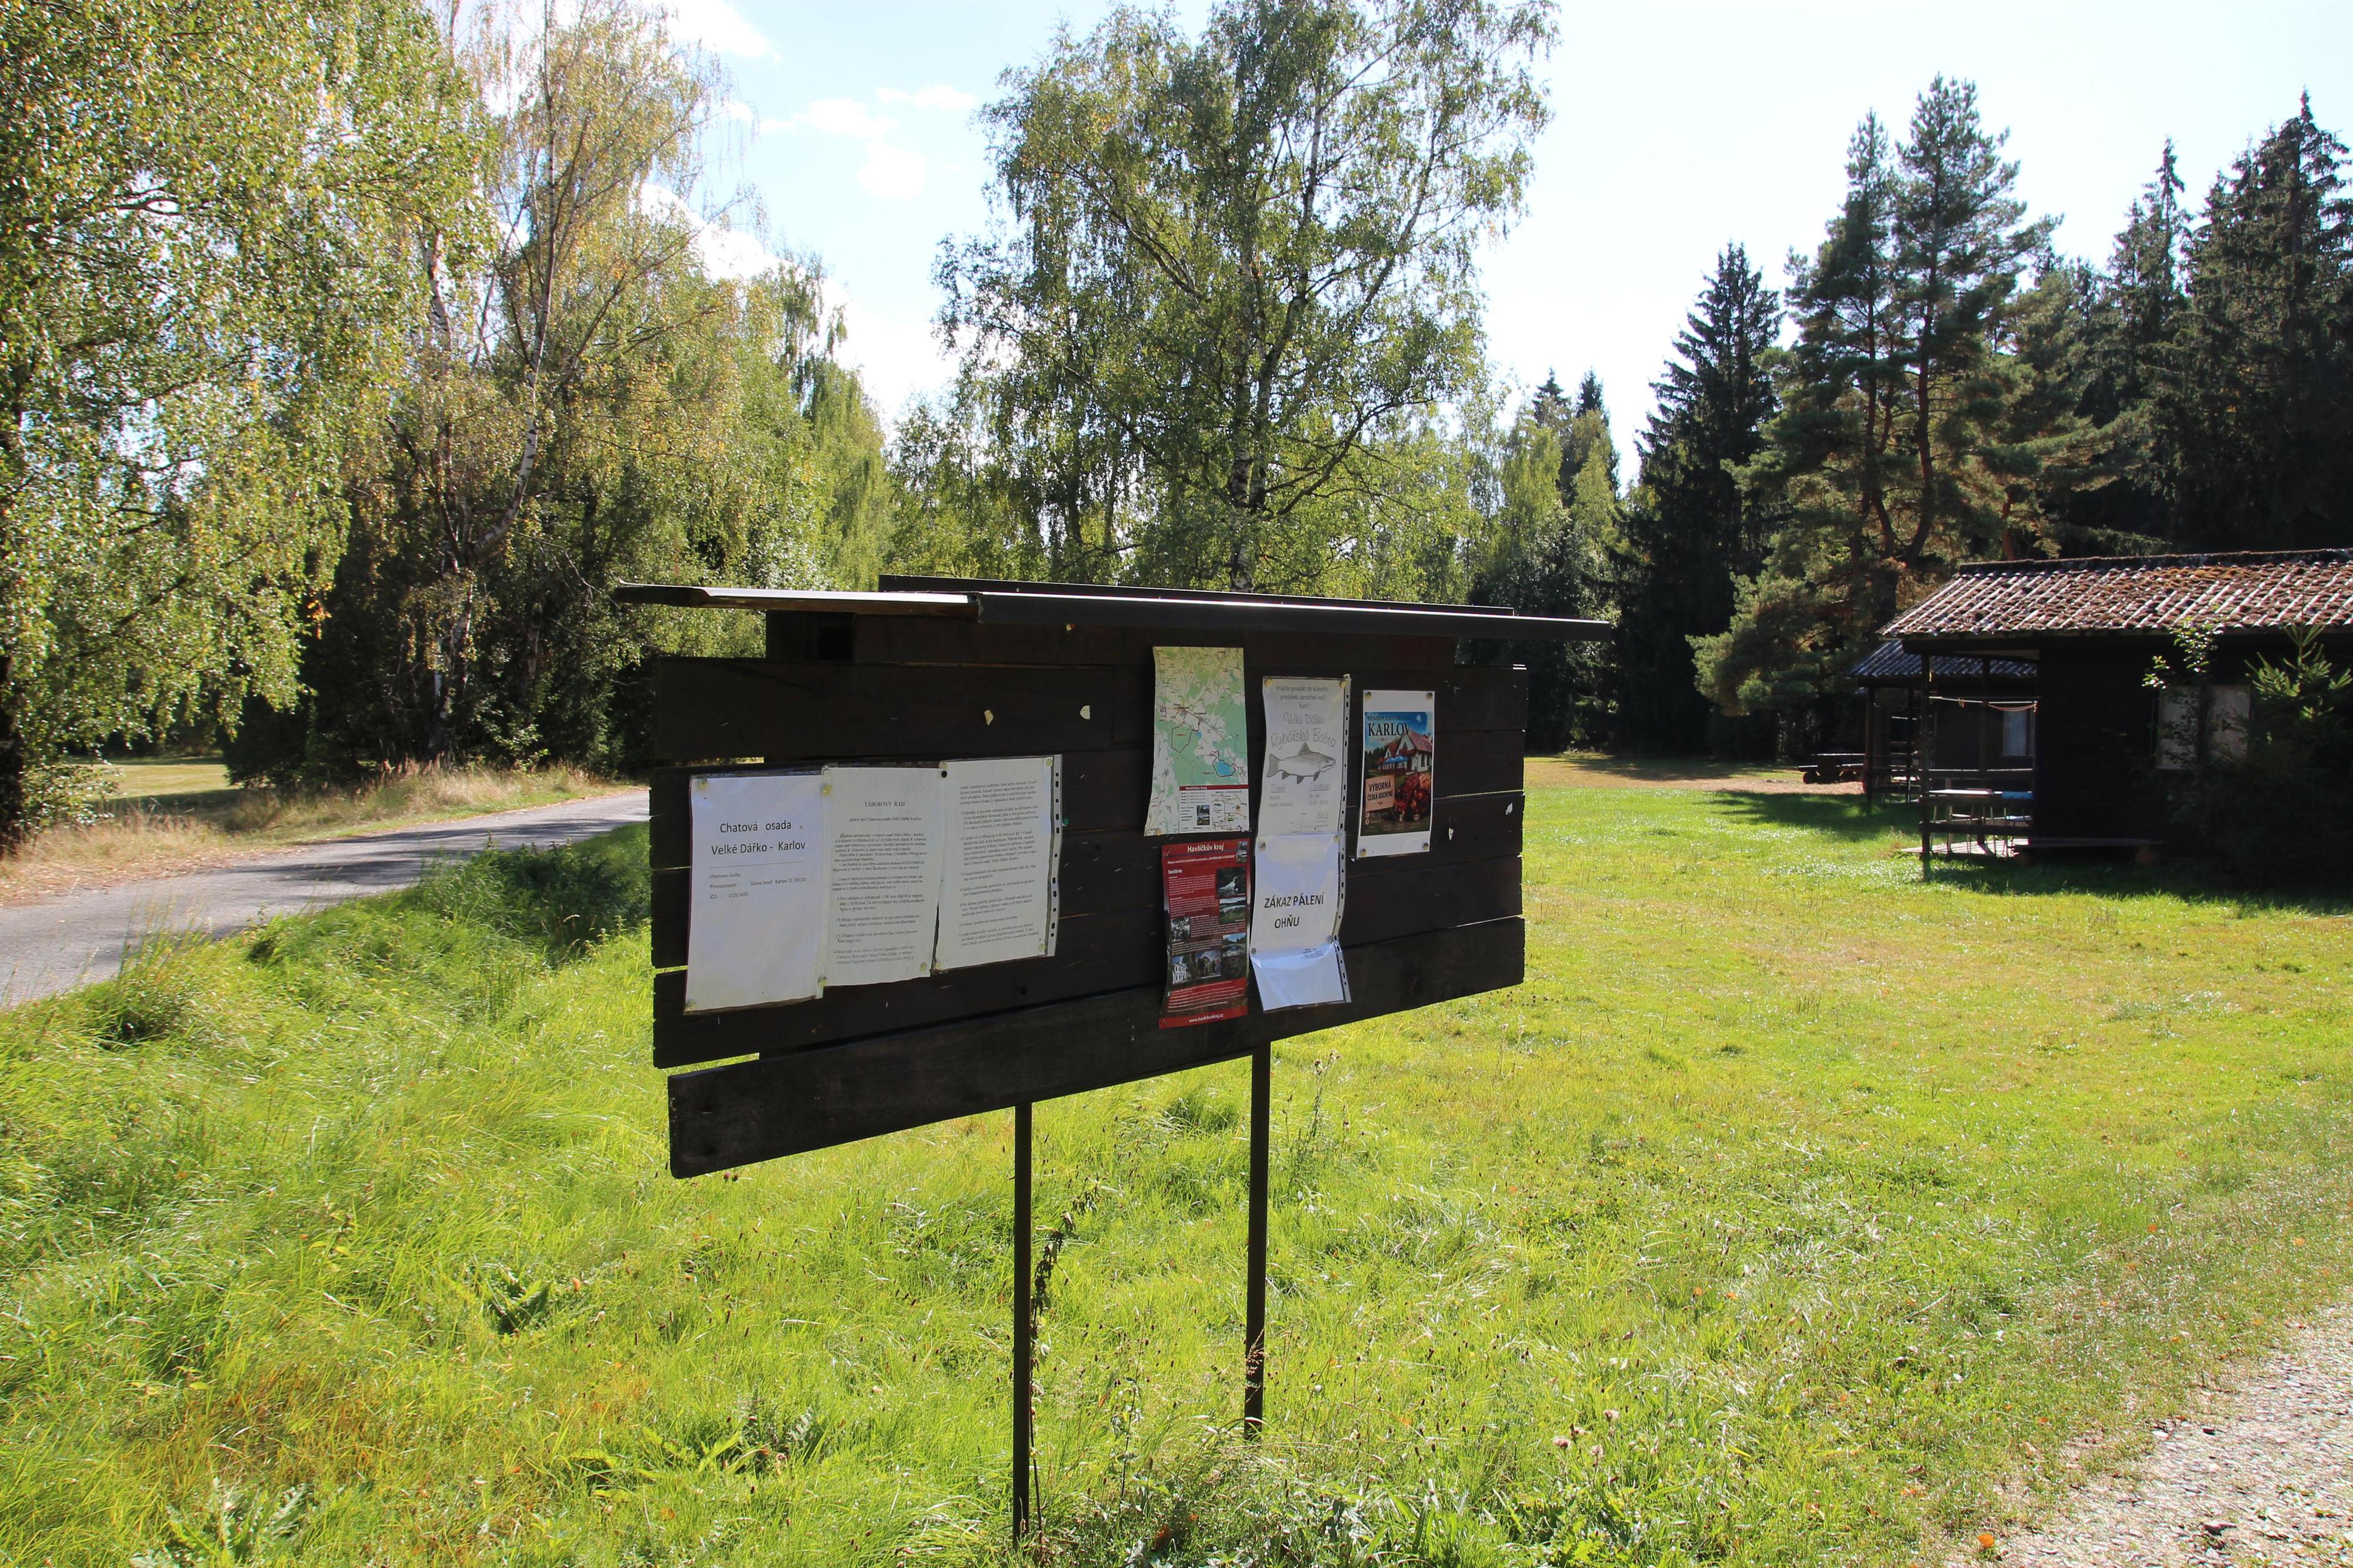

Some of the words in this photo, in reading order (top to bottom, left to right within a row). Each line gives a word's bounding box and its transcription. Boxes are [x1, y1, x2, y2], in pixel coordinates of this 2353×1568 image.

[1368, 723, 1411, 736] KARLOV
[1271, 729, 1309, 750] Rybářská
[1369, 779, 1391, 792] VÝBORNÁ
[720, 822, 758, 833] Chatová
[765, 820, 791, 830] osada
[711, 844, 738, 855] Velké
[741, 842, 767, 853] Dářko
[778, 840, 805, 851] Karlov
[1264, 895, 1291, 908] ZÁKAZ
[1294, 892, 1325, 906] PÁLENÍ
[1275, 914, 1299, 929] OHŇU
